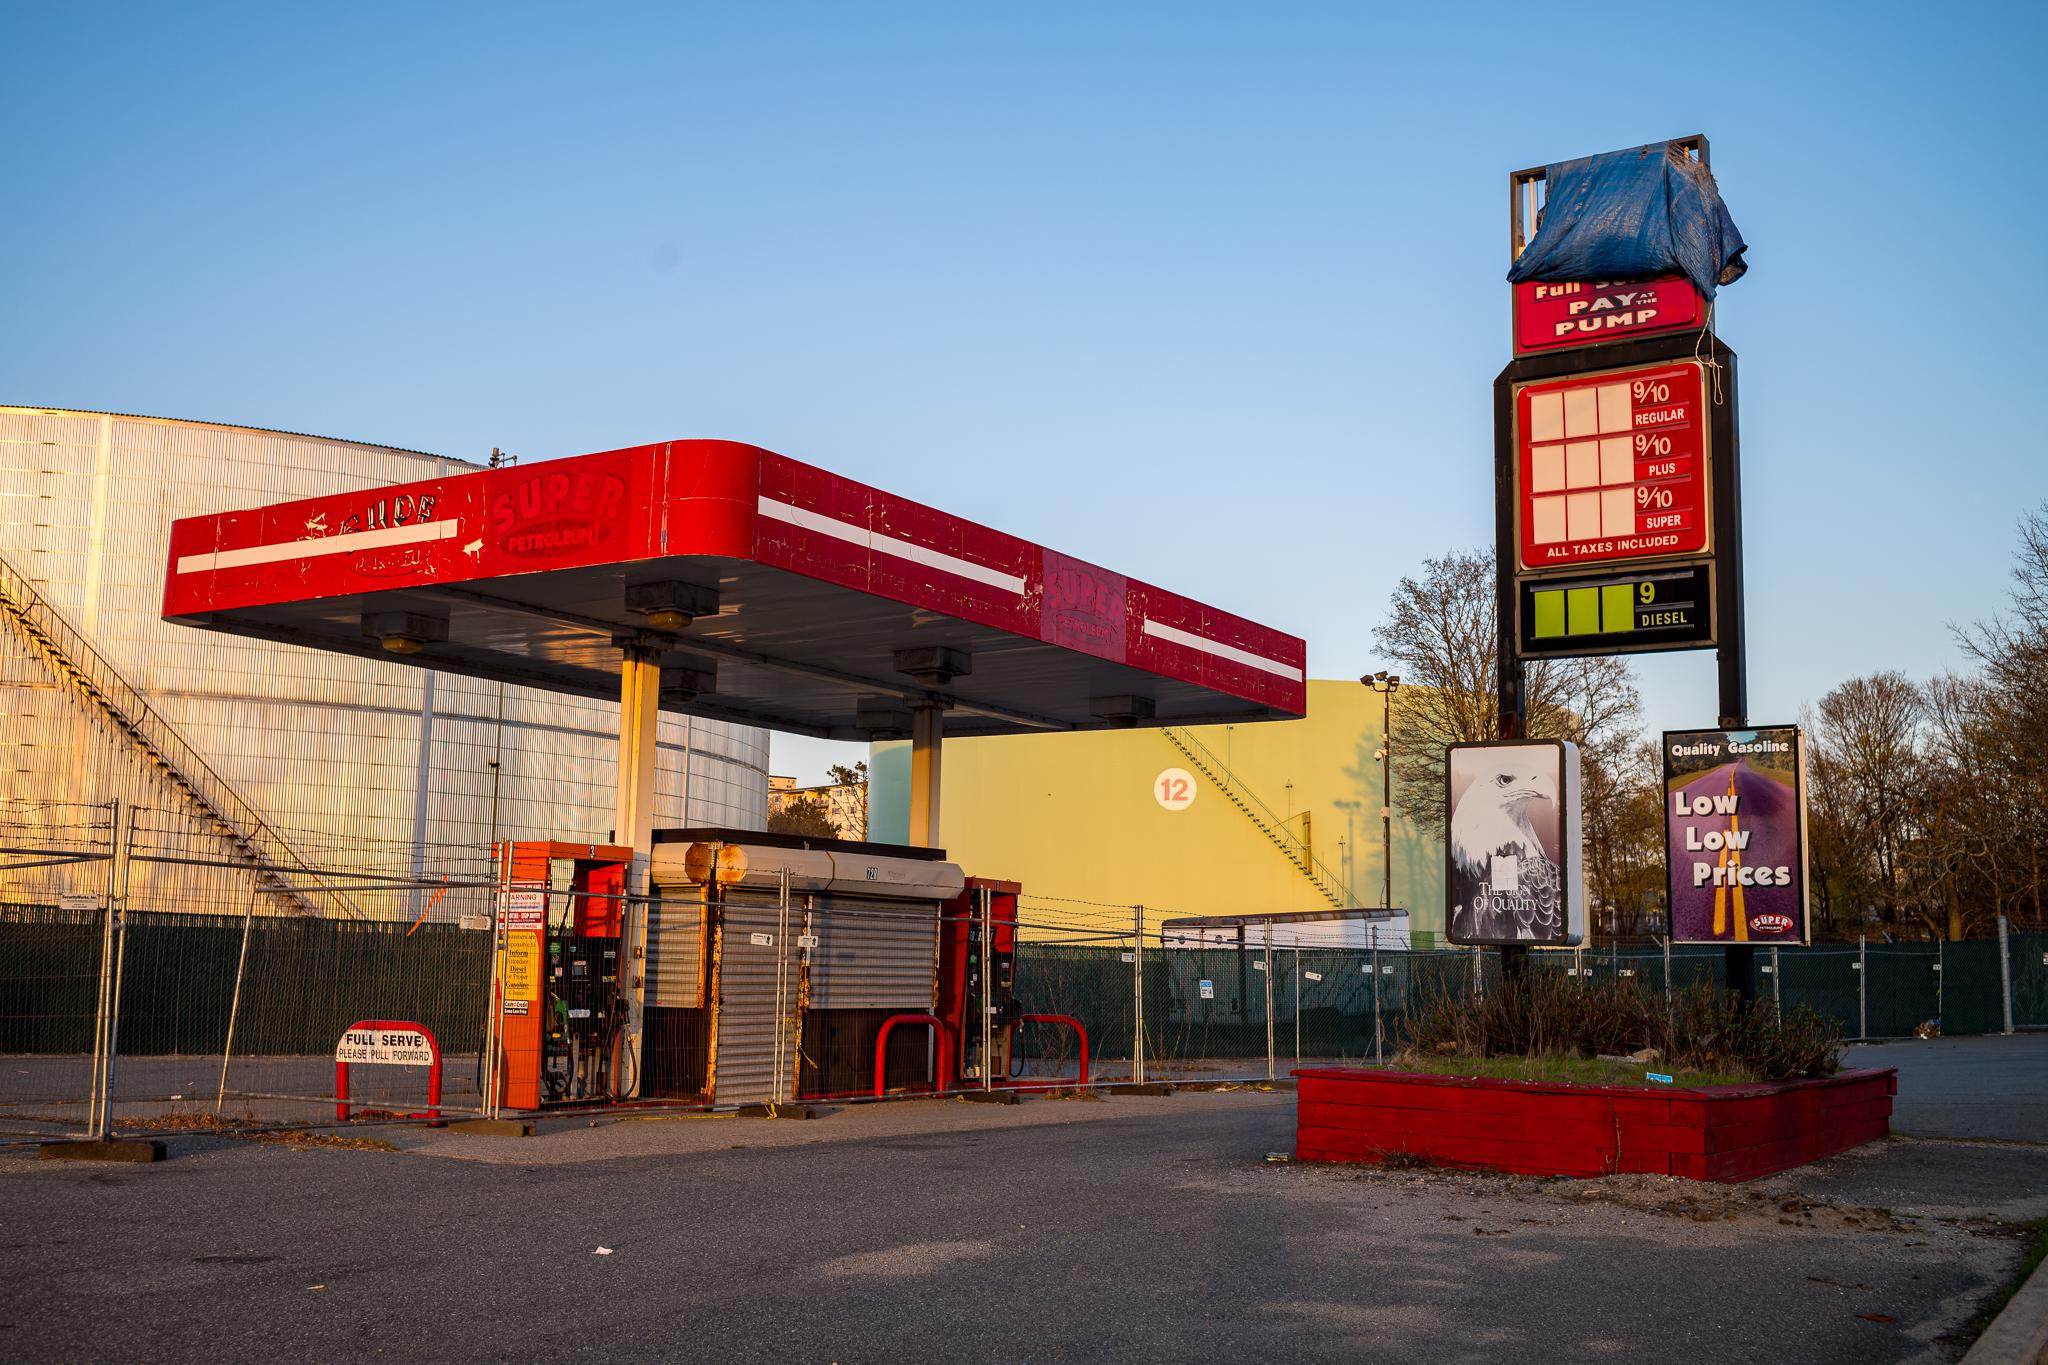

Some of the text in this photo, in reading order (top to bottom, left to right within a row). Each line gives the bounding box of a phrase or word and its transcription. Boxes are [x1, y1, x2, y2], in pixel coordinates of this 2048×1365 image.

[1536, 281, 1581, 299] Full
[1569, 292, 1638, 315] PAY
[1555, 309, 1657, 336] PUMP
[1635, 408, 1684, 425] REGULAR
[1649, 463, 1676, 475] PLUS
[492, 472, 627, 535] SUPER
[1646, 515, 1681, 528] SUPER
[508, 526, 600, 552] PETROLEUM
[1547, 535, 1678, 557] ALL TAXES INCLUDED
[1640, 582, 1655, 604] 9
[1642, 612, 1687, 626] DIESEL
[1672, 740, 1789, 757] Quality Gasoline
[1161, 779, 1188, 801] 12
[1676, 792, 1738, 815] Low
[1687, 827, 1750, 850] Low
[1694, 860, 1790, 886] Prices
[1473, 897, 1538, 913] OF QUALITY
[1754, 916, 1788, 926] SUPER
[346, 1034, 422, 1046] FULL SERVE
[339, 1049, 429, 1061] PLEASE PULL FORWARD
